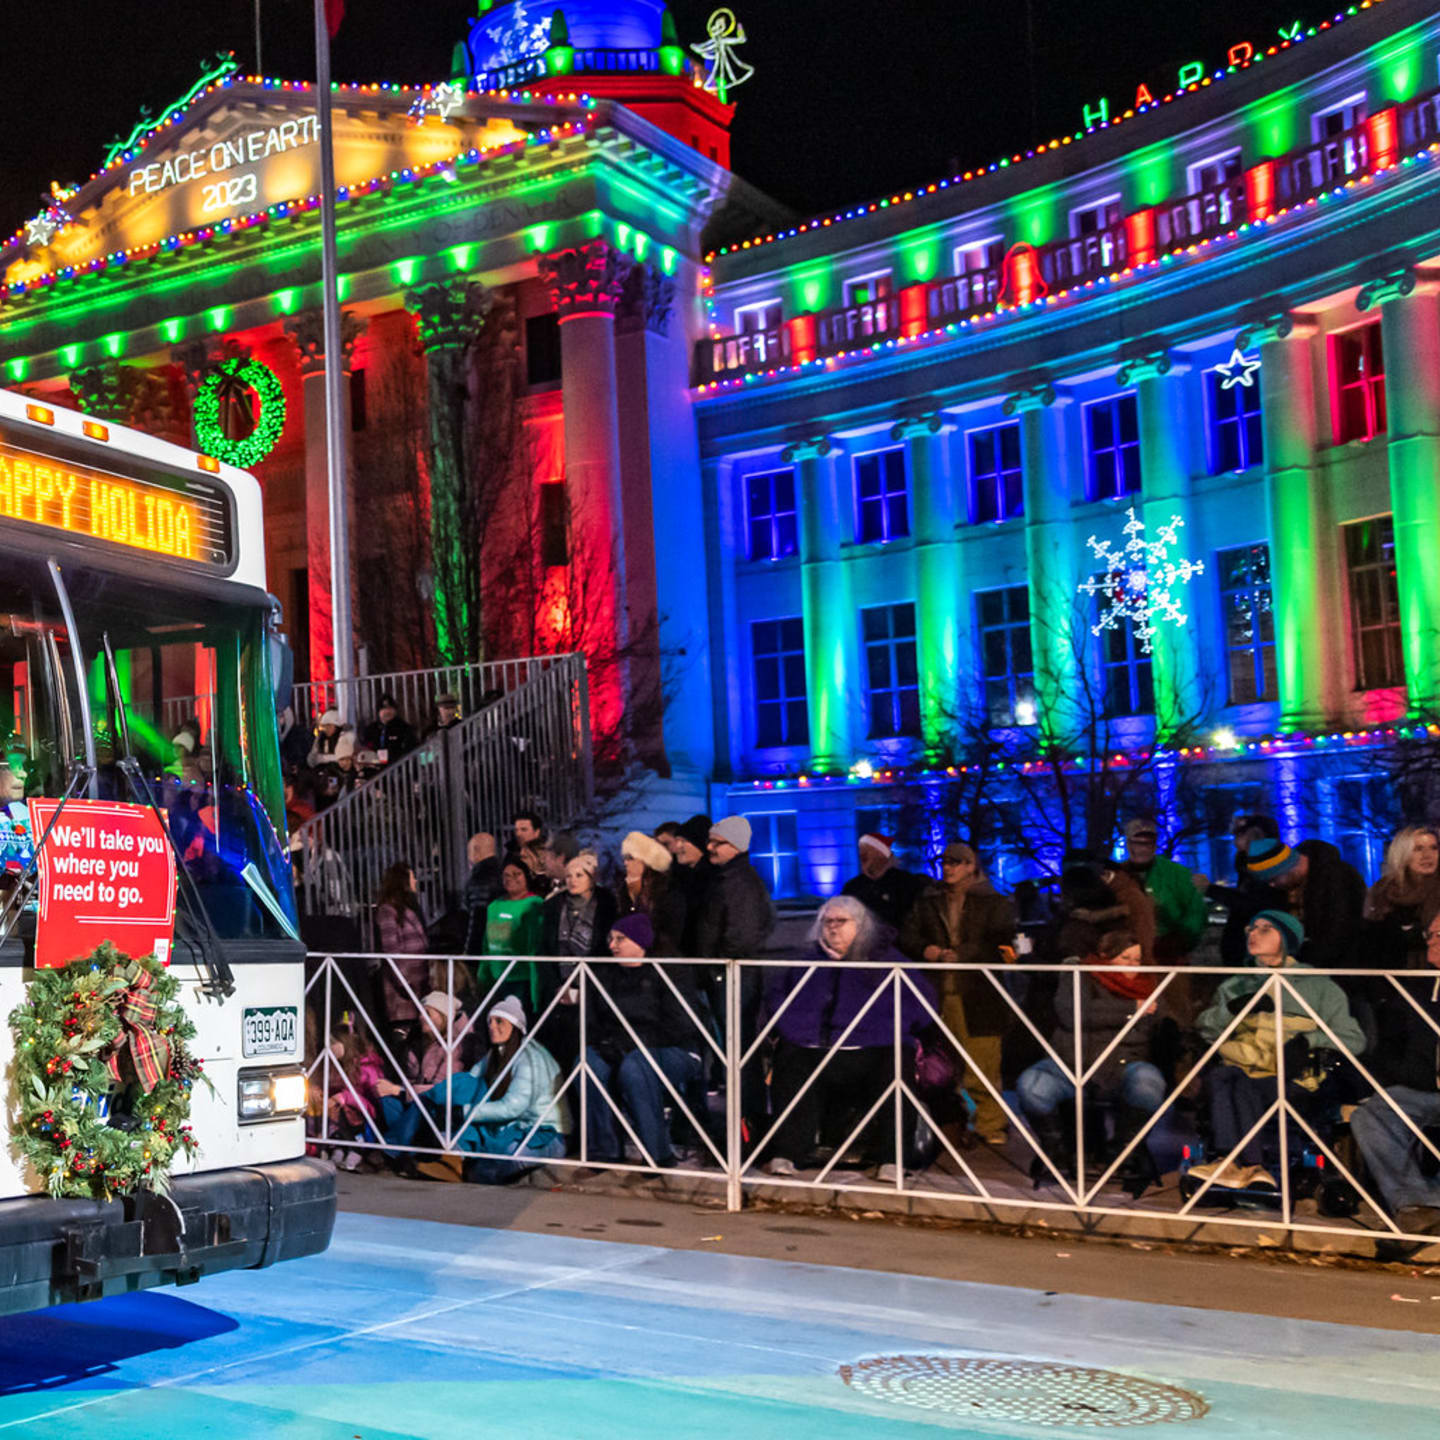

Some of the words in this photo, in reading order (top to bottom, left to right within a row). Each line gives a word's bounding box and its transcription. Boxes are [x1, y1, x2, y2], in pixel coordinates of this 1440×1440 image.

[129, 150, 208, 197] PEACE
[210, 138, 245, 173] ON
[201, 173, 257, 213] 2023
[89, 479, 192, 558] HOLIDA
[51, 825, 95, 849] We'll
[99, 829, 134, 851] take
[137, 835, 164, 857] you
[53, 852, 106, 876] where
[109, 860, 139, 882] you
[53, 880, 95, 902] need
[98, 882, 115, 903] to
[118, 886, 144, 909] go.
